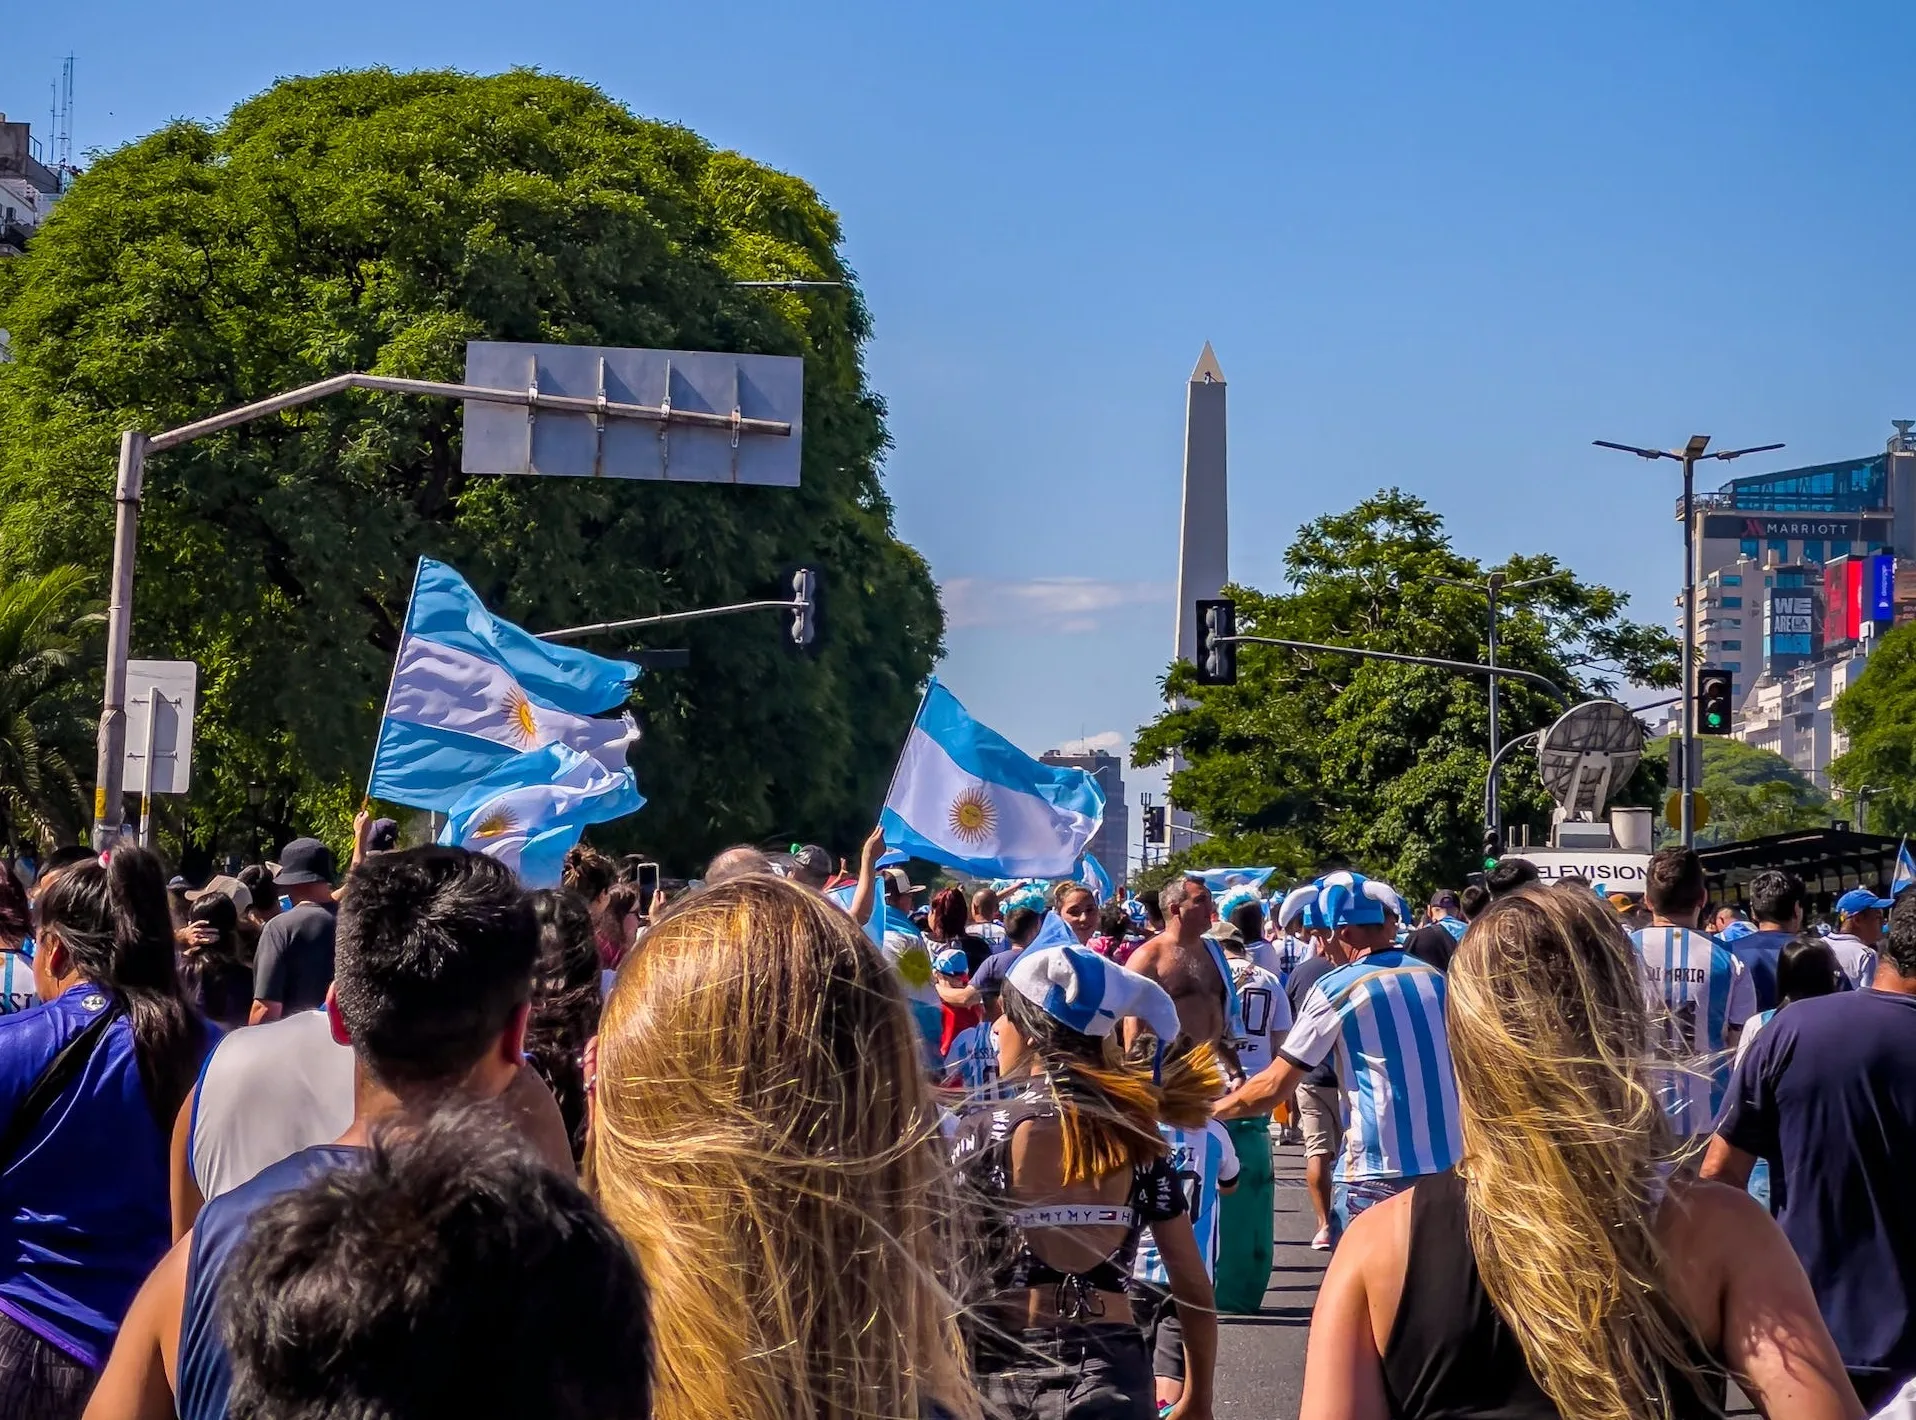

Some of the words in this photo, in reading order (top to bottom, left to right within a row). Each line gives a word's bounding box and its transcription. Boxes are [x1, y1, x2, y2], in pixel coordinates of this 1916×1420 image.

[1766, 523, 1849, 536] MARRIOTT
[1774, 598, 1812, 614] WE
[1774, 616, 1791, 632] ARE
